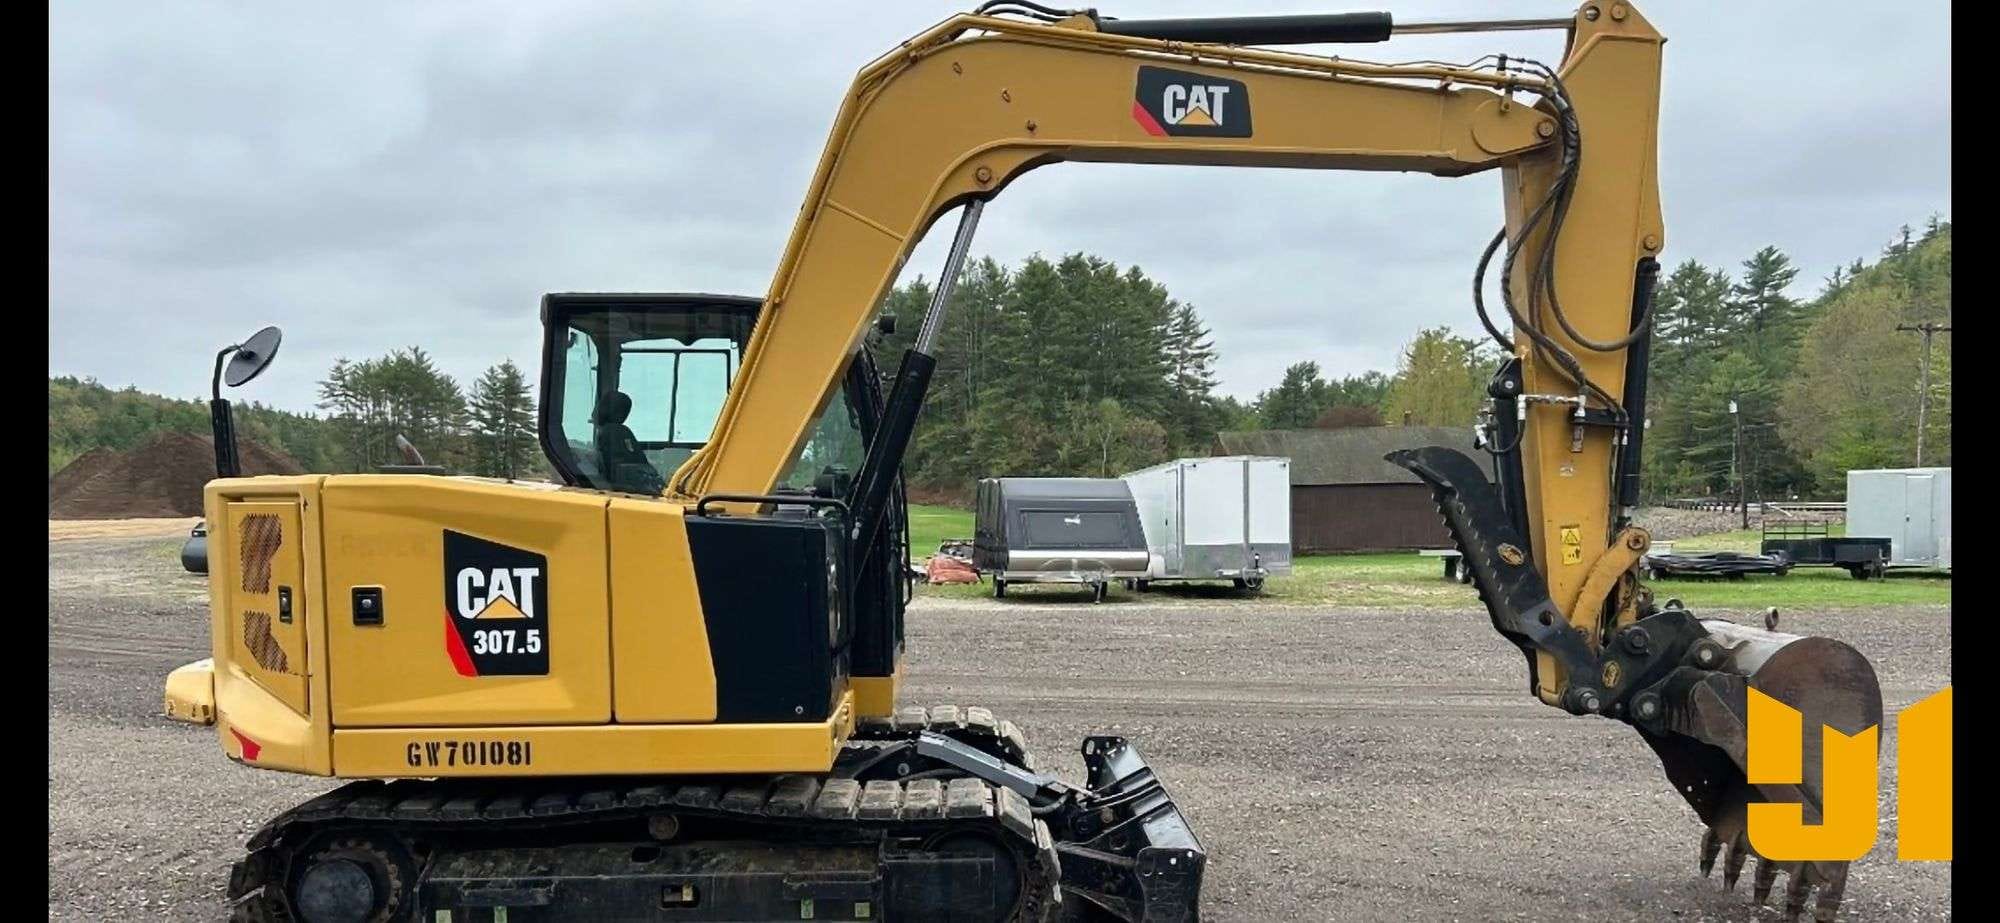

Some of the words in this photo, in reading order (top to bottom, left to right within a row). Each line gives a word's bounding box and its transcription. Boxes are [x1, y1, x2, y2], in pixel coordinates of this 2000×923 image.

[1163, 84, 1230, 127] CAT
[457, 567, 540, 620] CAT
[473, 629, 542, 655] 307.5
[406, 741, 532, 767] GW701081
